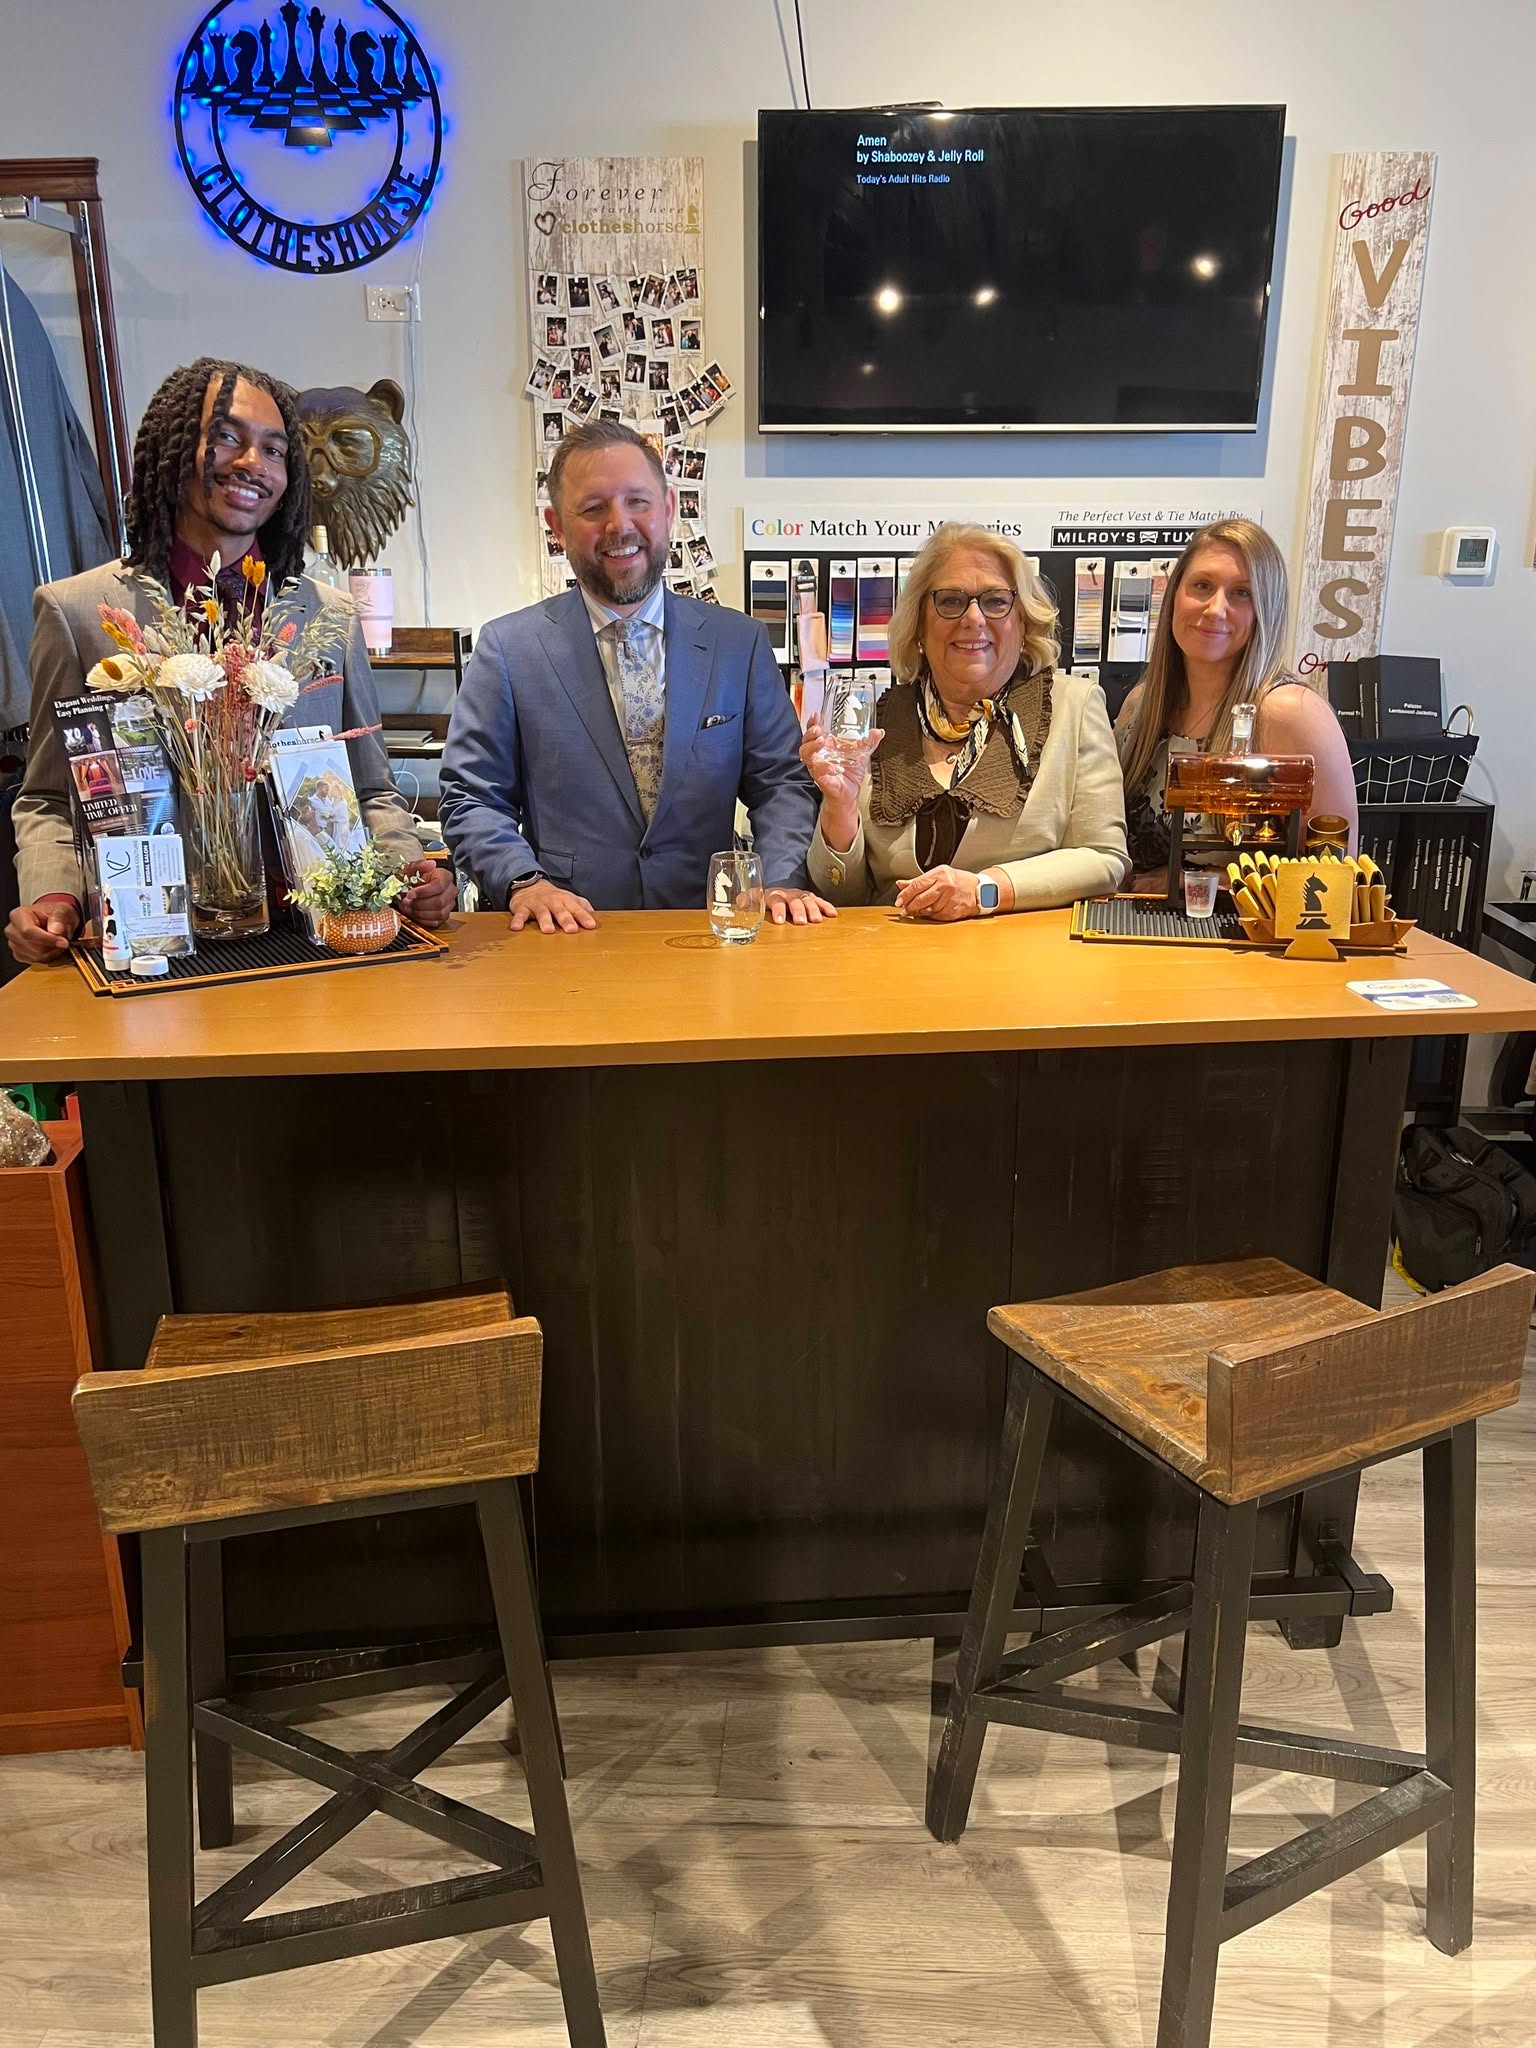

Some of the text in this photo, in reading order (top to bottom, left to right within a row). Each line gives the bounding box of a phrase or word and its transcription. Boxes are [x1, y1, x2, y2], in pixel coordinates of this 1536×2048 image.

[857, 134, 887, 147] Amen
[856, 149, 984, 165] by Shaboozey & Jelly Roll
[527, 161, 663, 202] Forever
[857, 174, 951, 186] Today's Adult Hits Radio
[592, 200, 684, 214] starts here
[1338, 178, 1431, 231] Good
[197, 163, 430, 266] CLOTHESHORSE
[1312, 239, 1411, 640] VIBES
[1058, 510, 1079, 521] The
[1083, 510, 1124, 524] Perfect
[1128, 510, 1151, 521] Vest
[1155, 510, 1164, 521] &
[1168, 510, 1185, 521] Tie
[1189, 510, 1225, 521] Match
[751, 518, 803, 536] Color
[810, 518, 868, 537] Match
[874, 519, 921, 537] Your
[1057, 531, 1136, 543] MILROY'S
[54, 699, 80, 709] Elegant
[56, 709, 72, 718] Easy
[269, 736, 320, 749] otheshorse
[130, 765, 162, 781] LOVE
[82, 798, 117, 812] LIMITED
[86, 810, 106, 820] TIME
[108, 804, 138, 816] OFFER
